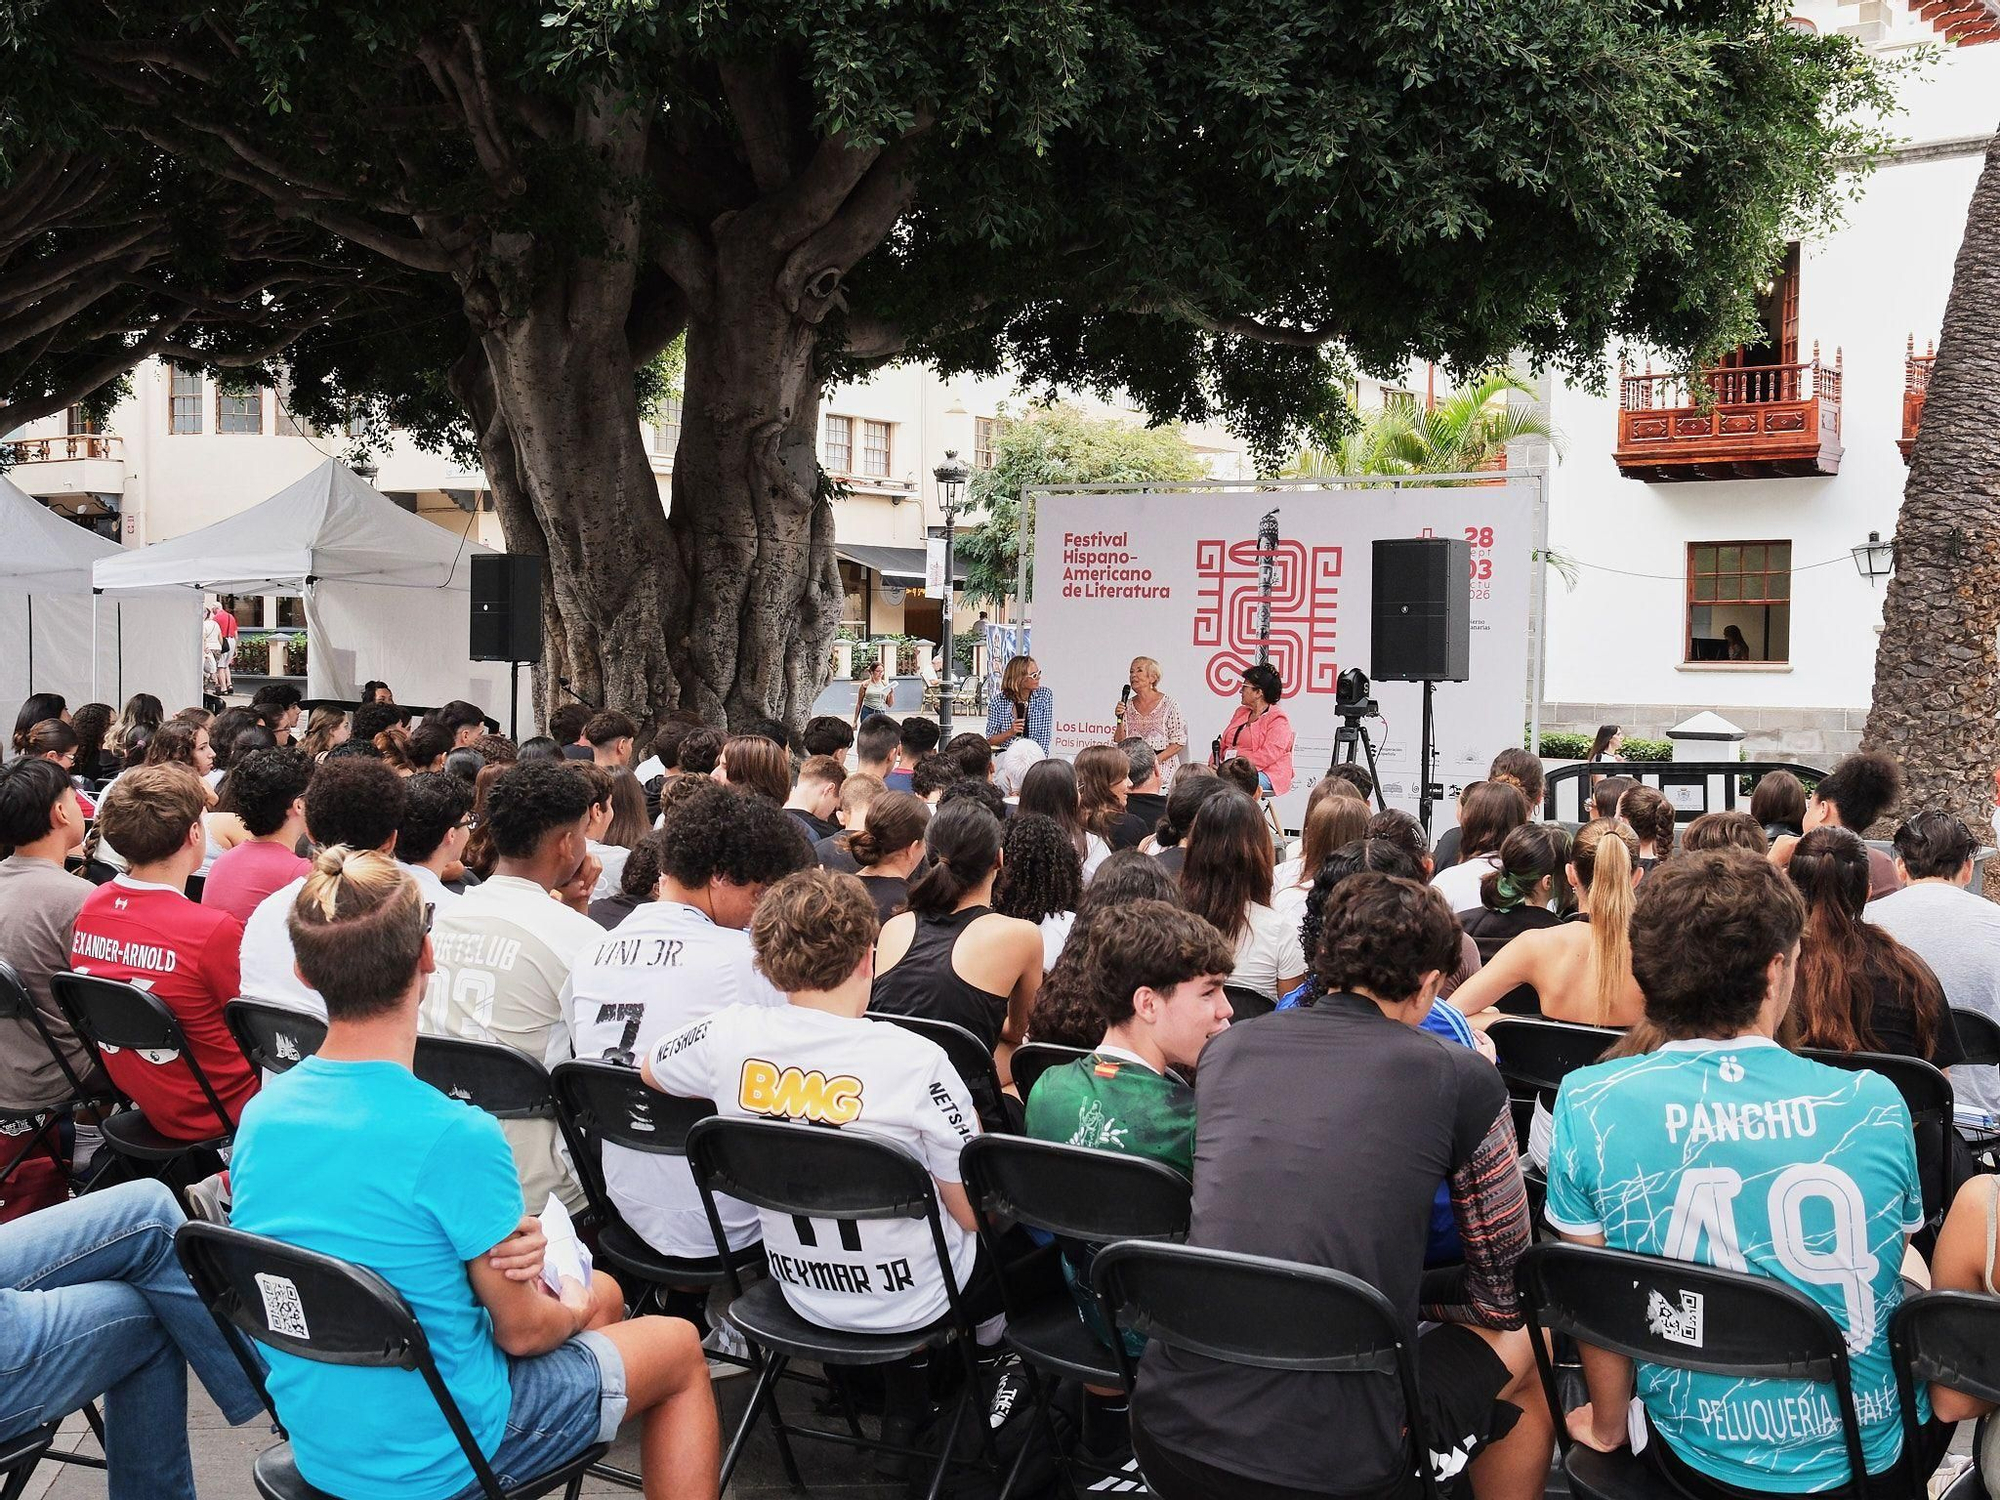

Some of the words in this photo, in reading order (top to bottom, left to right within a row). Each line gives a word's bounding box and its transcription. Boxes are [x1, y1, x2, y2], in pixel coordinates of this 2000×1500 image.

[1064, 531, 1127, 547] Festival
[1465, 527, 1494, 548] 28
[1063, 548, 1138, 567] Hispano-
[1470, 549, 1491, 558] ept
[1063, 565, 1152, 581] Americano
[1062, 583, 1081, 598] de
[1085, 582, 1170, 598] Literatura
[1469, 590, 1490, 600] 026
[1056, 721, 1076, 732] Los
[1078, 721, 1116, 735] Llanos
[72, 930, 177, 973] EXANDER-ARNOLD
[594, 939, 641, 966] VINI
[594, 1003, 645, 1066] 7
[656, 1020, 713, 1064] NETSHOES
[738, 1058, 863, 1125] BMG
[1665, 1099, 1817, 1144] PANCHO
[768, 1249, 873, 1294] NEYMAR
[876, 1257, 915, 1292] JR
